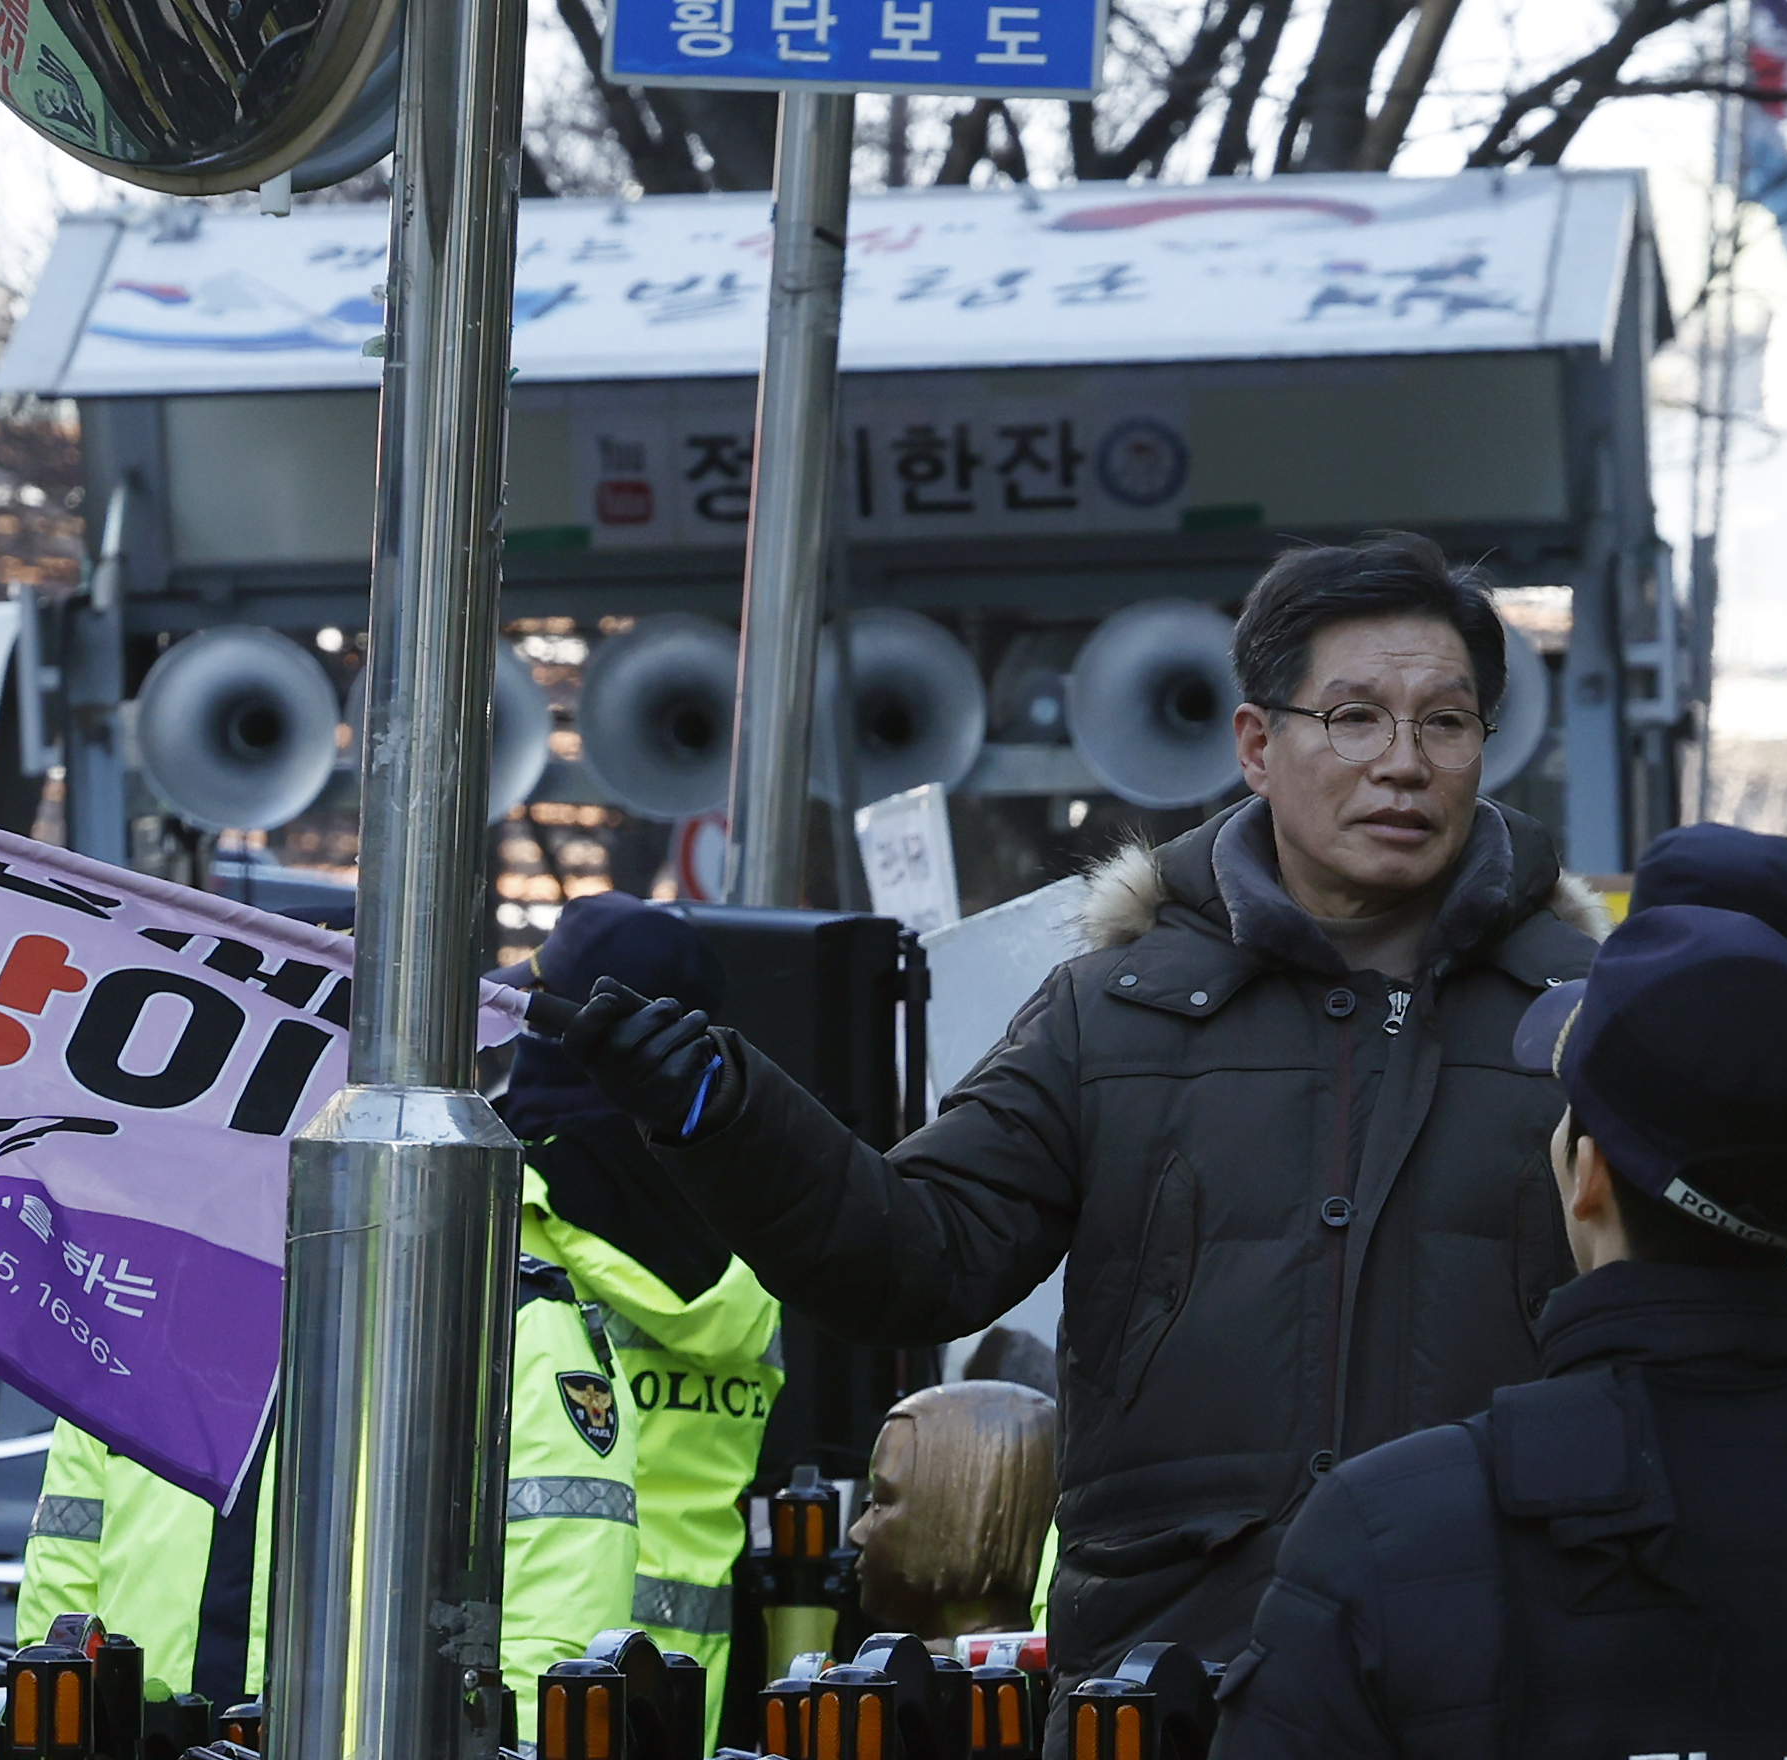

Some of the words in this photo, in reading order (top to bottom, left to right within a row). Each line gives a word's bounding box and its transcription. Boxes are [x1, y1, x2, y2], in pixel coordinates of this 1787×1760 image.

[669, 0, 1048, 64] 횡단보도
[686, 417, 1085, 522] 정한잔
[62, 1240, 157, 1318] 하는
